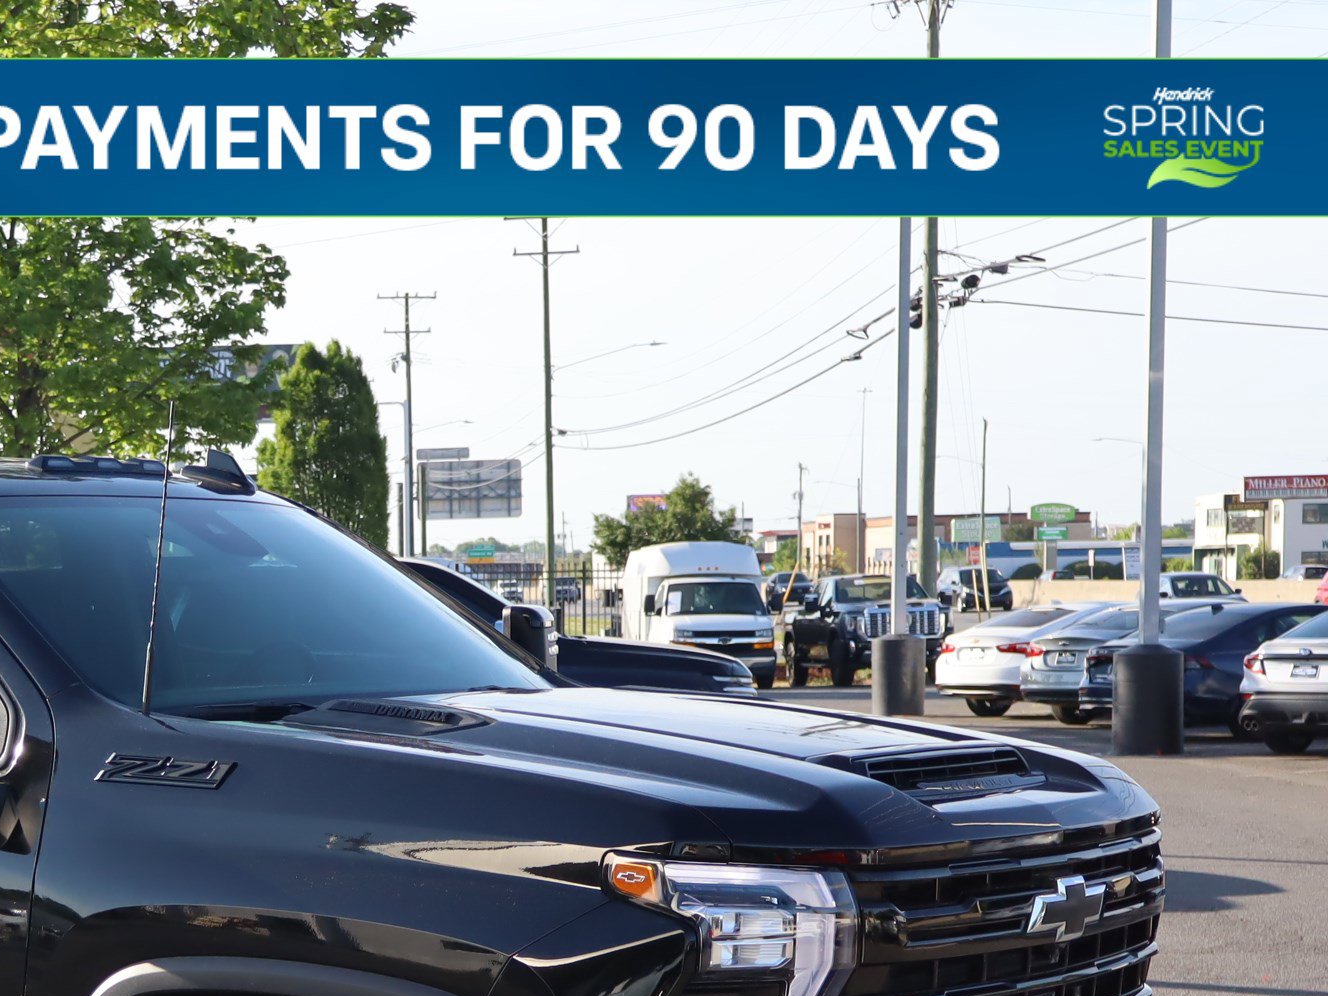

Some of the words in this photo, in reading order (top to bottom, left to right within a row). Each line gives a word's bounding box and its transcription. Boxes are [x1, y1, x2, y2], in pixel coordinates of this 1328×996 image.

[1248, 478, 1288, 489] MILLER
[1293, 476, 1327, 488] PIANO
[93, 751, 239, 791] Z71
